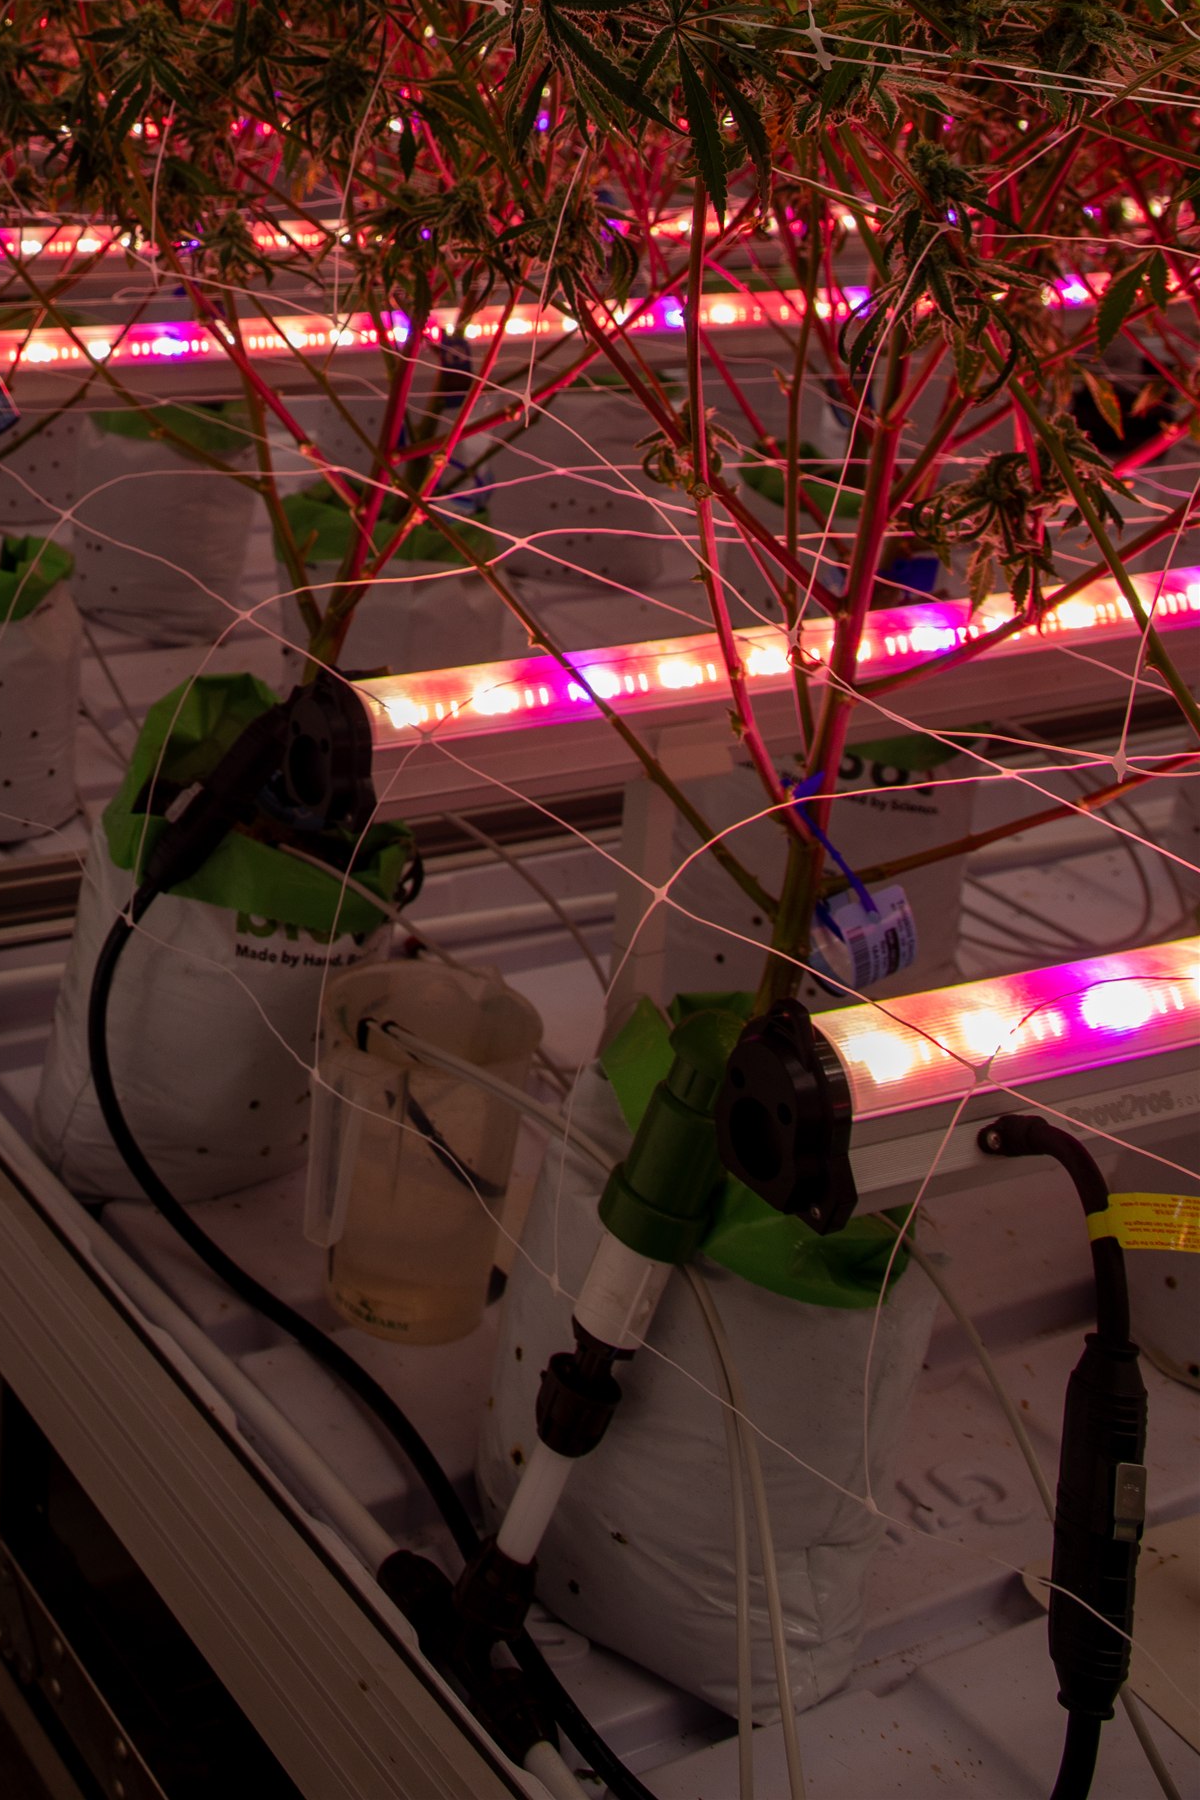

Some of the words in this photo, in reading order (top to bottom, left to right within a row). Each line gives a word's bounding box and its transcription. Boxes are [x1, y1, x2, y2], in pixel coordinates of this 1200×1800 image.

[235, 943, 278, 964] Made
[281, 949, 299, 968] by
[1066, 1089, 1175, 1132] GrowPros
